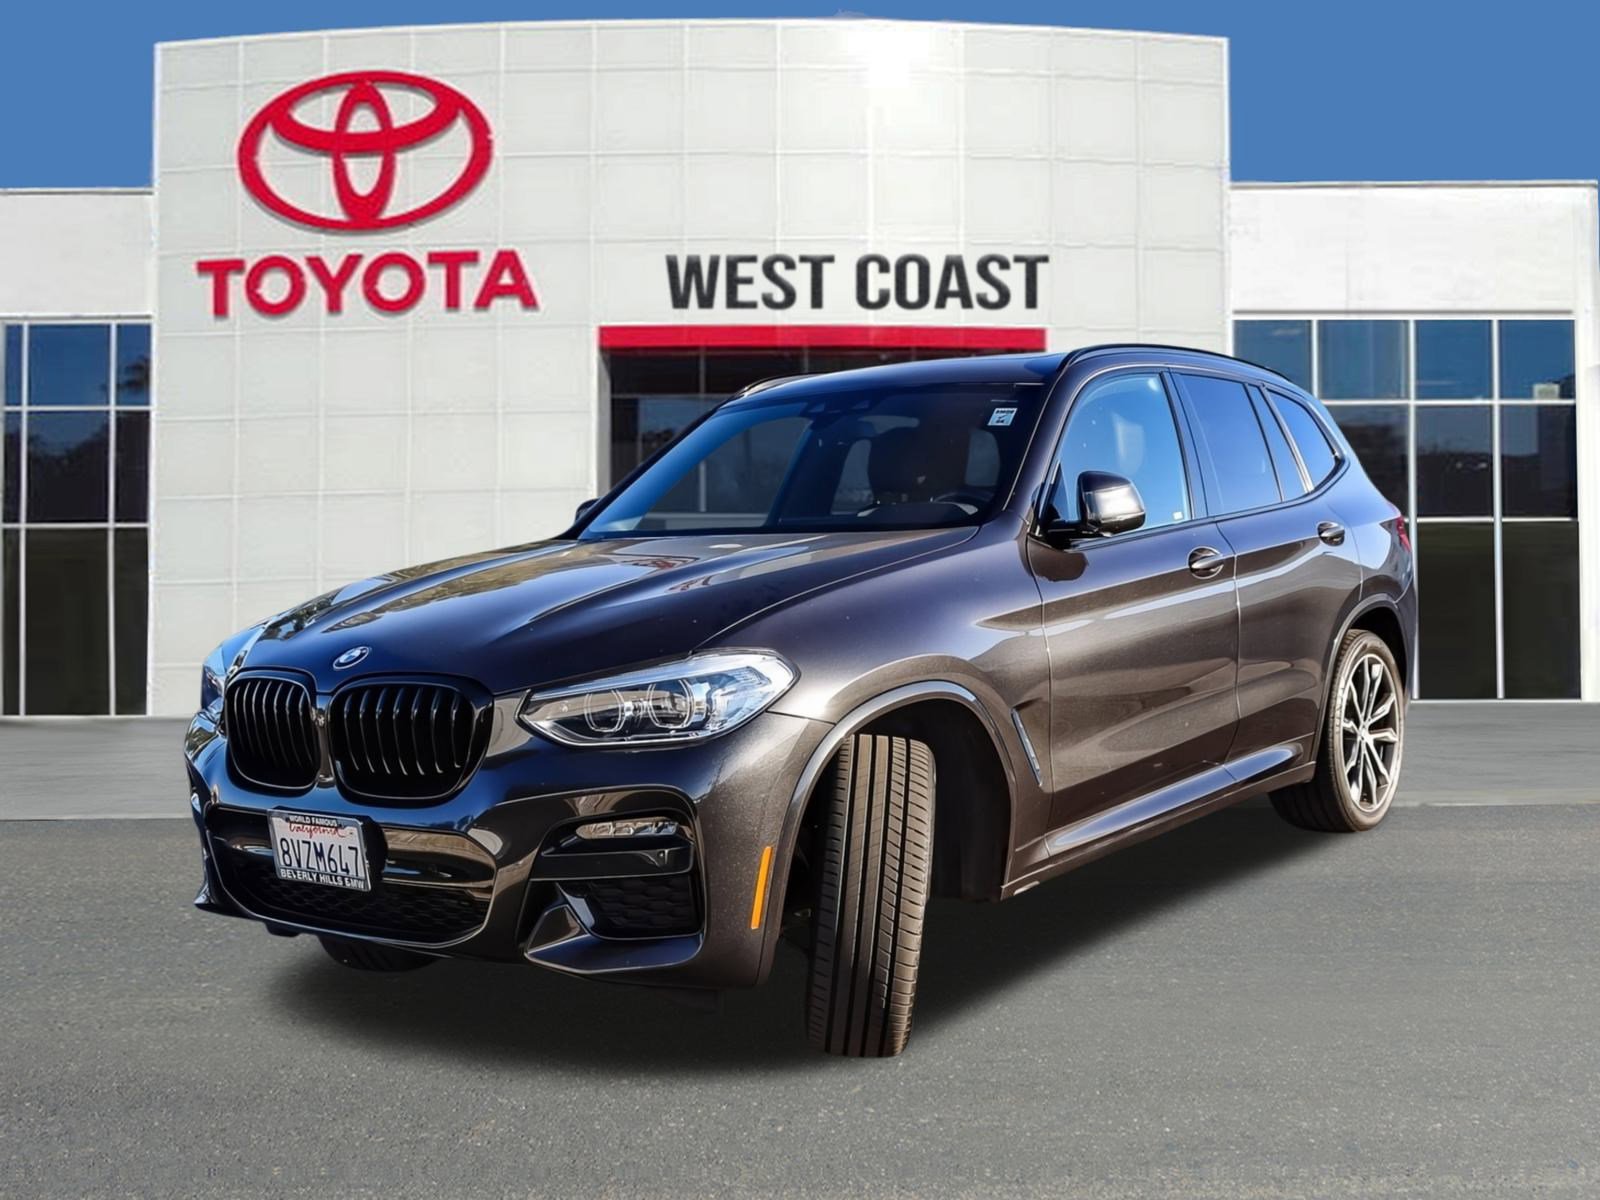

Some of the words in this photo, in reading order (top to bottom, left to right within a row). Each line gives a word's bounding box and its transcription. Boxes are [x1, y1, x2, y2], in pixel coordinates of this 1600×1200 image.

[196, 250, 538, 317] TOYOTA
[665, 254, 834, 309] WEST
[856, 254, 1049, 309] COAST
[280, 837, 359, 877] 8VZM647
[281, 868, 317, 881] BEVERLY
[319, 874, 343, 886] HILLS
